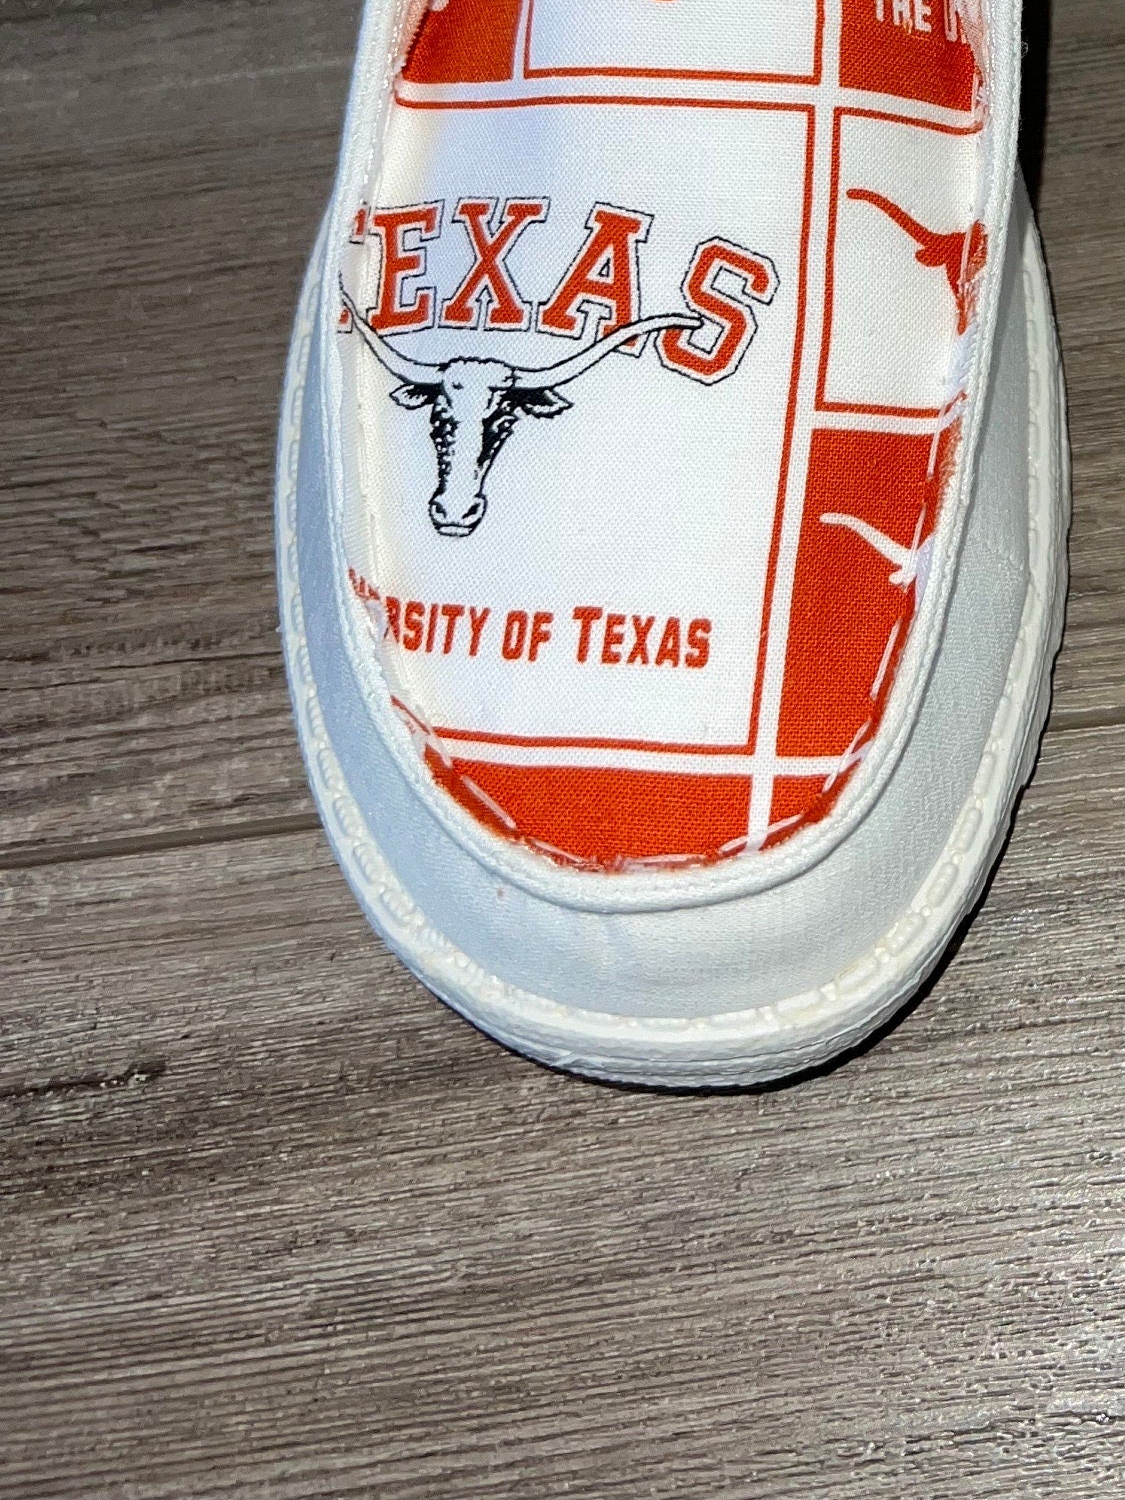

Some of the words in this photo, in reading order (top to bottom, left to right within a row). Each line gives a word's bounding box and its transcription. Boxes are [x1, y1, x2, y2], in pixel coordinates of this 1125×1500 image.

[338, 197, 780, 385] EXAS
[501, 610, 554, 662] OF
[572, 606, 713, 669] TEXAS
